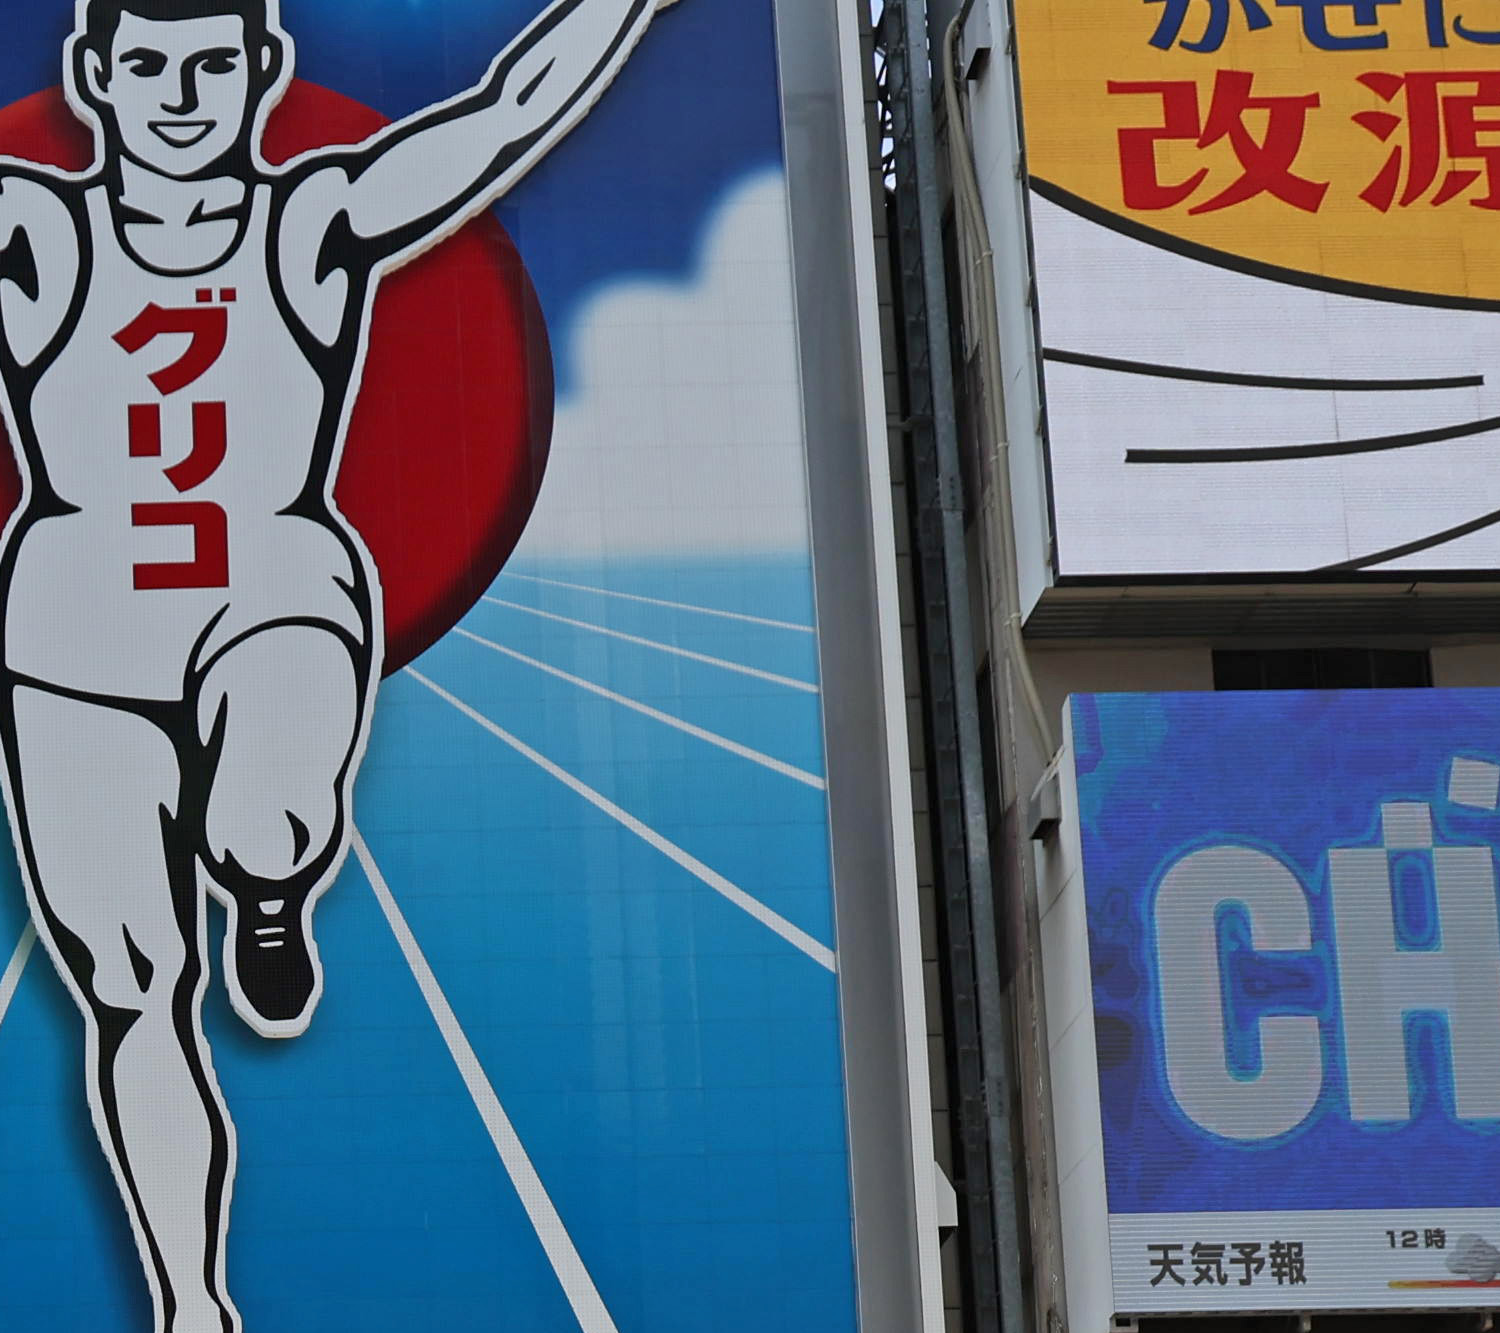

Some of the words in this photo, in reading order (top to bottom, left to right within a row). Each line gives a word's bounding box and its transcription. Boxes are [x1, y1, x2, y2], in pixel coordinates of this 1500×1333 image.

[111, 288, 237, 591] グリコ
[1147, 1240, 1308, 1287] 天気予報
